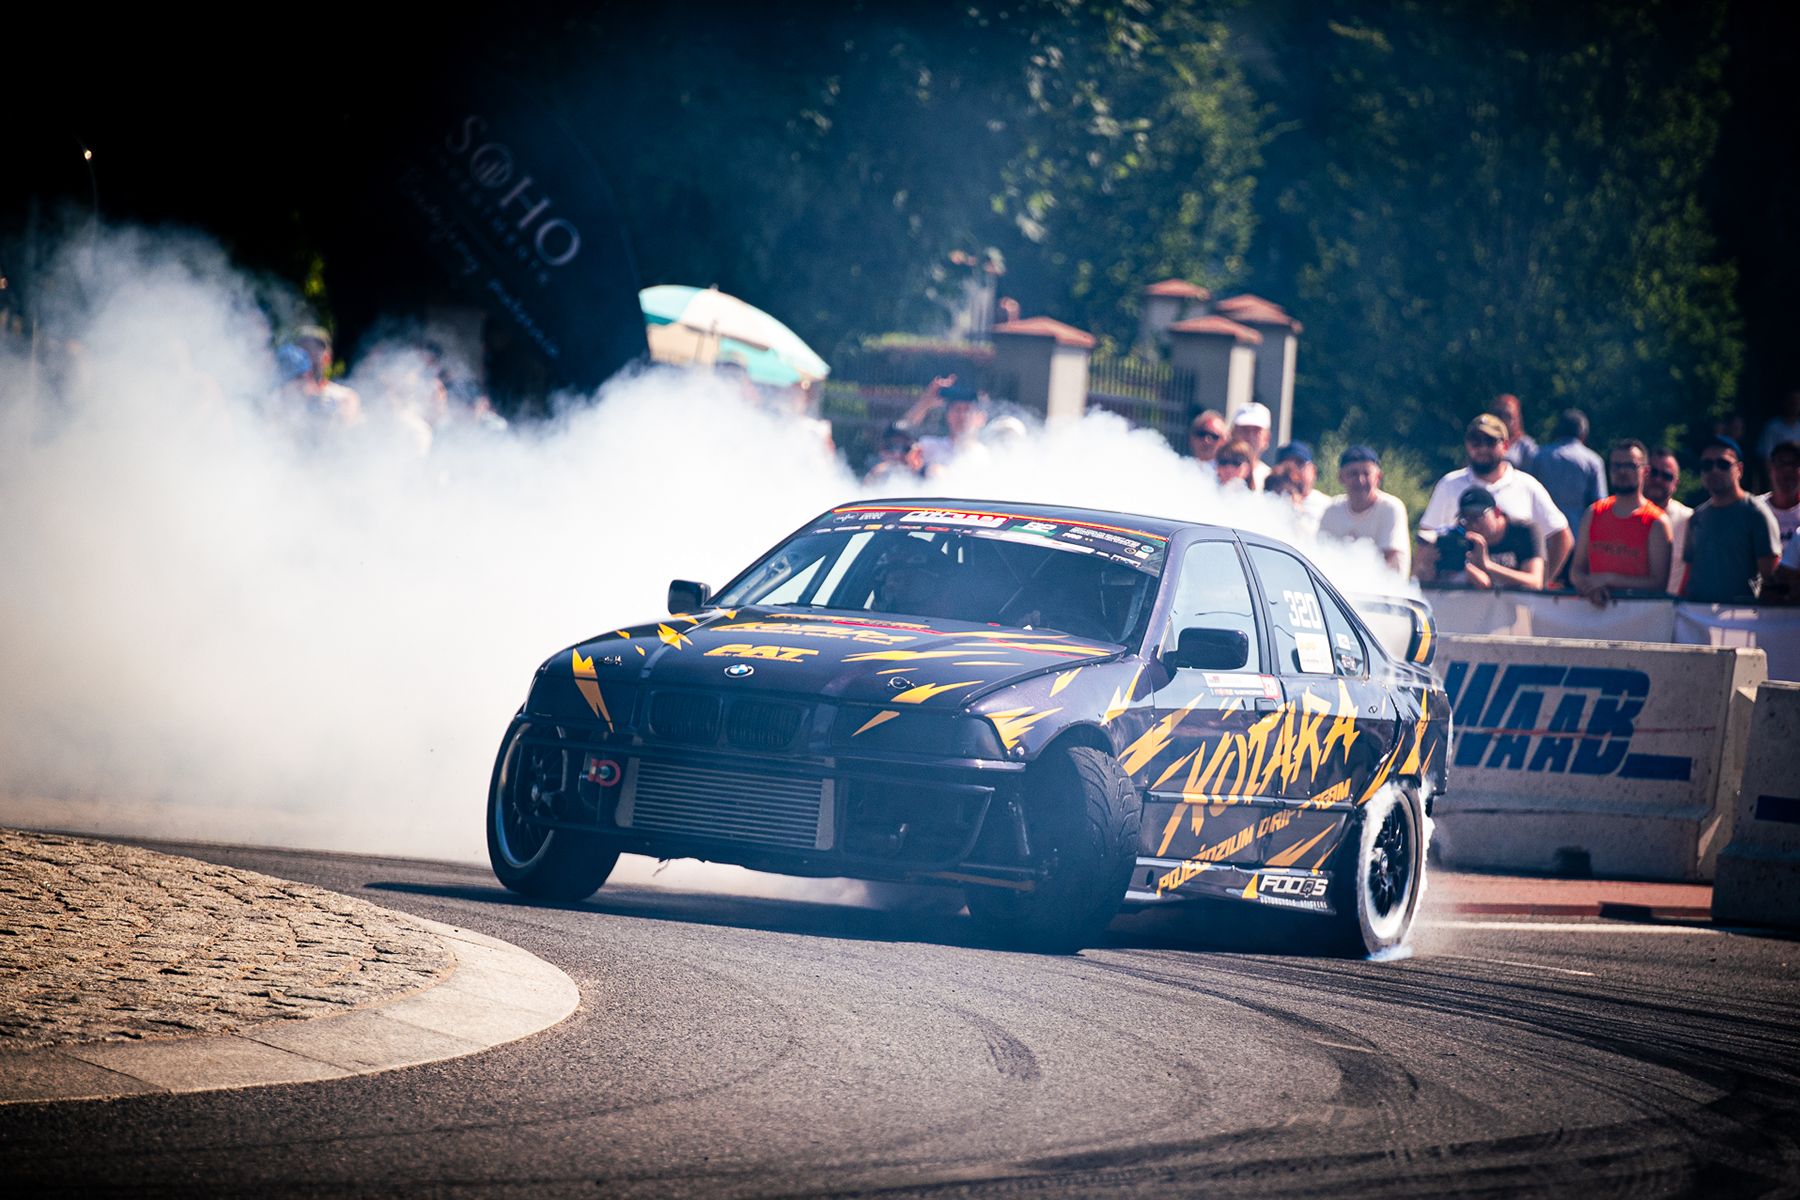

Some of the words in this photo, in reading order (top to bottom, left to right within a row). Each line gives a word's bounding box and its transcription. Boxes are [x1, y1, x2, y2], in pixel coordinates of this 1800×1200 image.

[444, 113, 582, 268] SOHO
[1282, 589, 1323, 630] 320
[1256, 800, 1312, 839] DRIFT
[1311, 778, 1352, 810] TEAM
